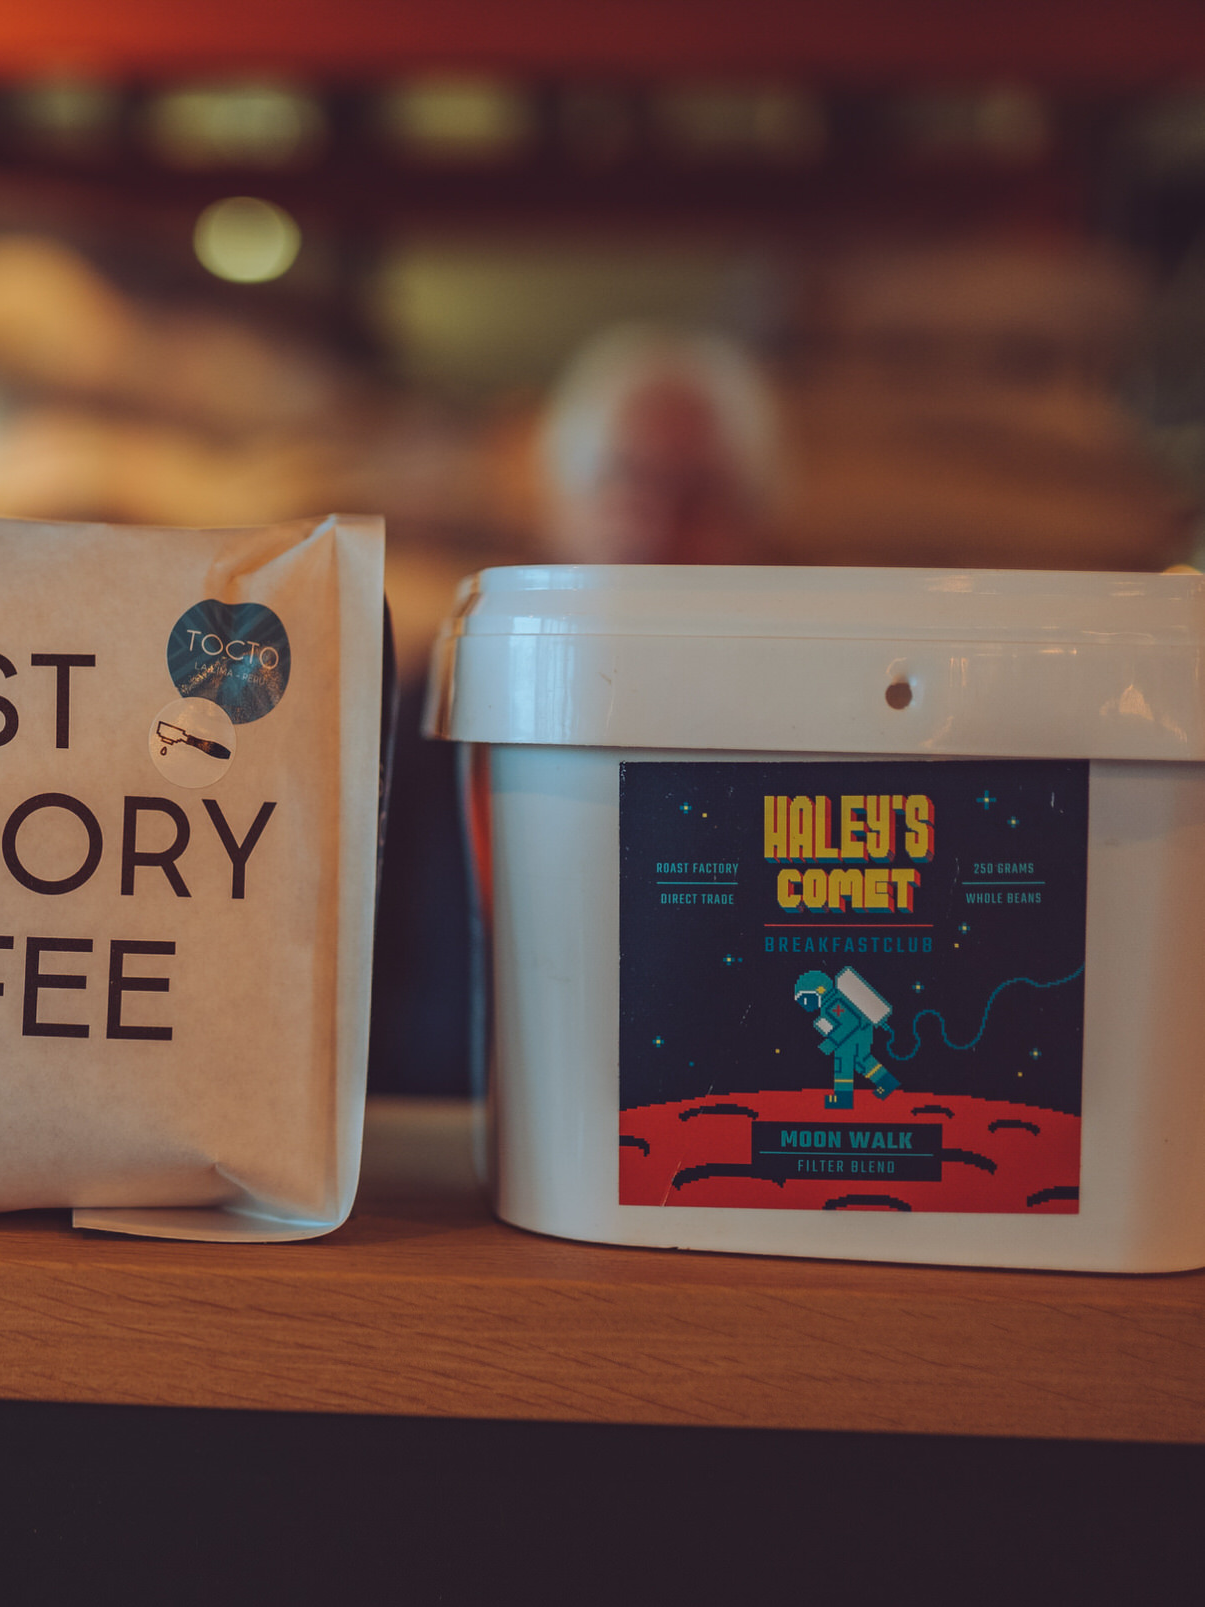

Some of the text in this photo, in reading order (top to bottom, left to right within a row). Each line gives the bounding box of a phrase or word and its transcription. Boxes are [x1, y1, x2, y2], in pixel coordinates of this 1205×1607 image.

[186, 629, 279, 670] TOCTO
[763, 795, 935, 864] HALEY'S
[656, 862, 739, 875] ROAST FACTORY
[973, 863, 1034, 874] 250 GRAMS
[660, 893, 735, 905] DIRECT TRADE
[776, 868, 921, 914] COMET
[965, 892, 1042, 904] WHOLE BEANS
[764, 936, 934, 953] BREAKFASTCLUB
[780, 1130, 913, 1149] MOON WALK
[797, 1159, 896, 1174] FILTER BLEND
